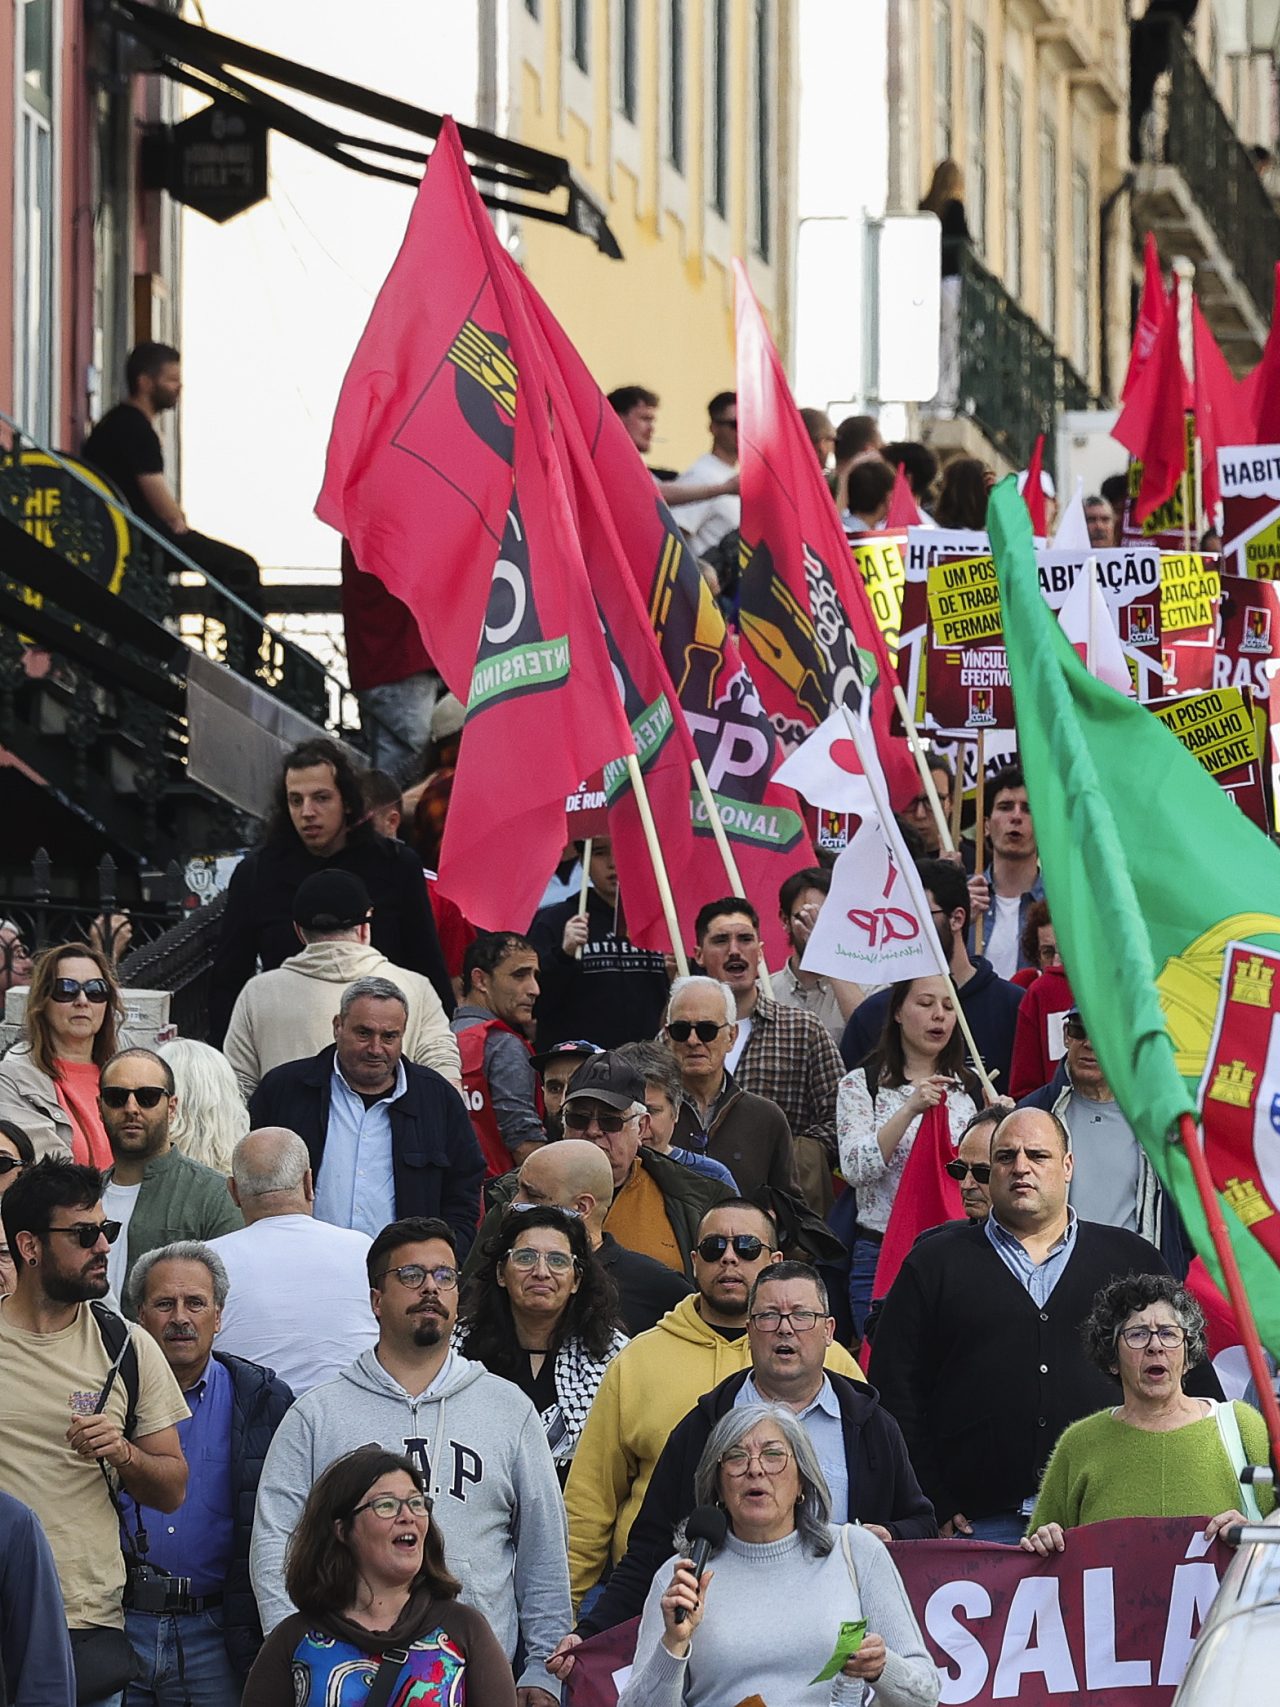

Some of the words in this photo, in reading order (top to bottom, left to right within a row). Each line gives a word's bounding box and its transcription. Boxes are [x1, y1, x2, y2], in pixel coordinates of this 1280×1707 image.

[943, 566, 968, 589] UM
[938, 594, 958, 616] DE
[1175, 693, 1224, 728] POSTO
[565, 793, 582, 812] DE
[354, 1434, 484, 1504] AP
